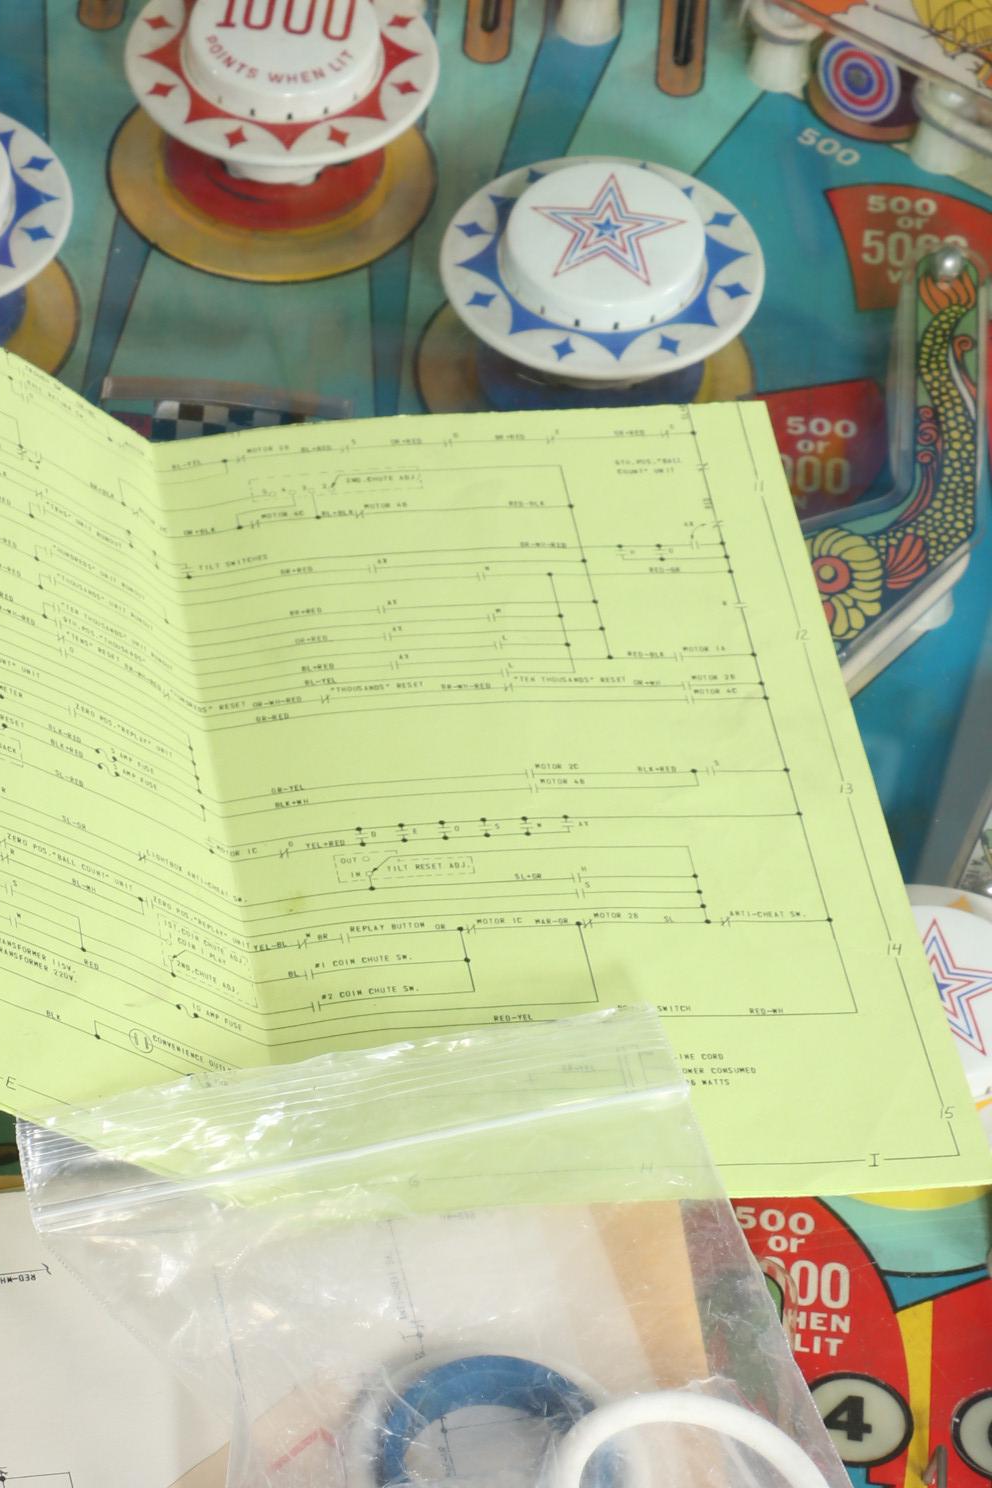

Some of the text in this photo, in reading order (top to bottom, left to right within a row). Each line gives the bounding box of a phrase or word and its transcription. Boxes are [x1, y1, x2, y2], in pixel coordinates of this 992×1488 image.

[205, 35, 355, 84] POINTS WHEN LIT
[797, 127, 862, 167] 500
[866, 194, 938, 217] 500
[897, 216, 930, 231] or
[785, 417, 858, 439] 500
[796, 438, 831, 454] or
[386, 859, 473, 873] TILT RESET ADJ.
[349, 920, 426, 934] REPLAY BUTTON
[332, 956, 357, 968] COIN
[361, 953, 391, 965] CHUTE
[338, 988, 364, 999] COIN
[368, 985, 397, 996] CHUTE
[700, 1052, 725, 1062] CORD
[710, 1066, 757, 1076] CONSUMED
[735, 1206, 816, 1236] 500
[767, 1234, 806, 1254] or
[793, 1333, 845, 1358] LIT
[823, 1394, 874, 1443] 4
